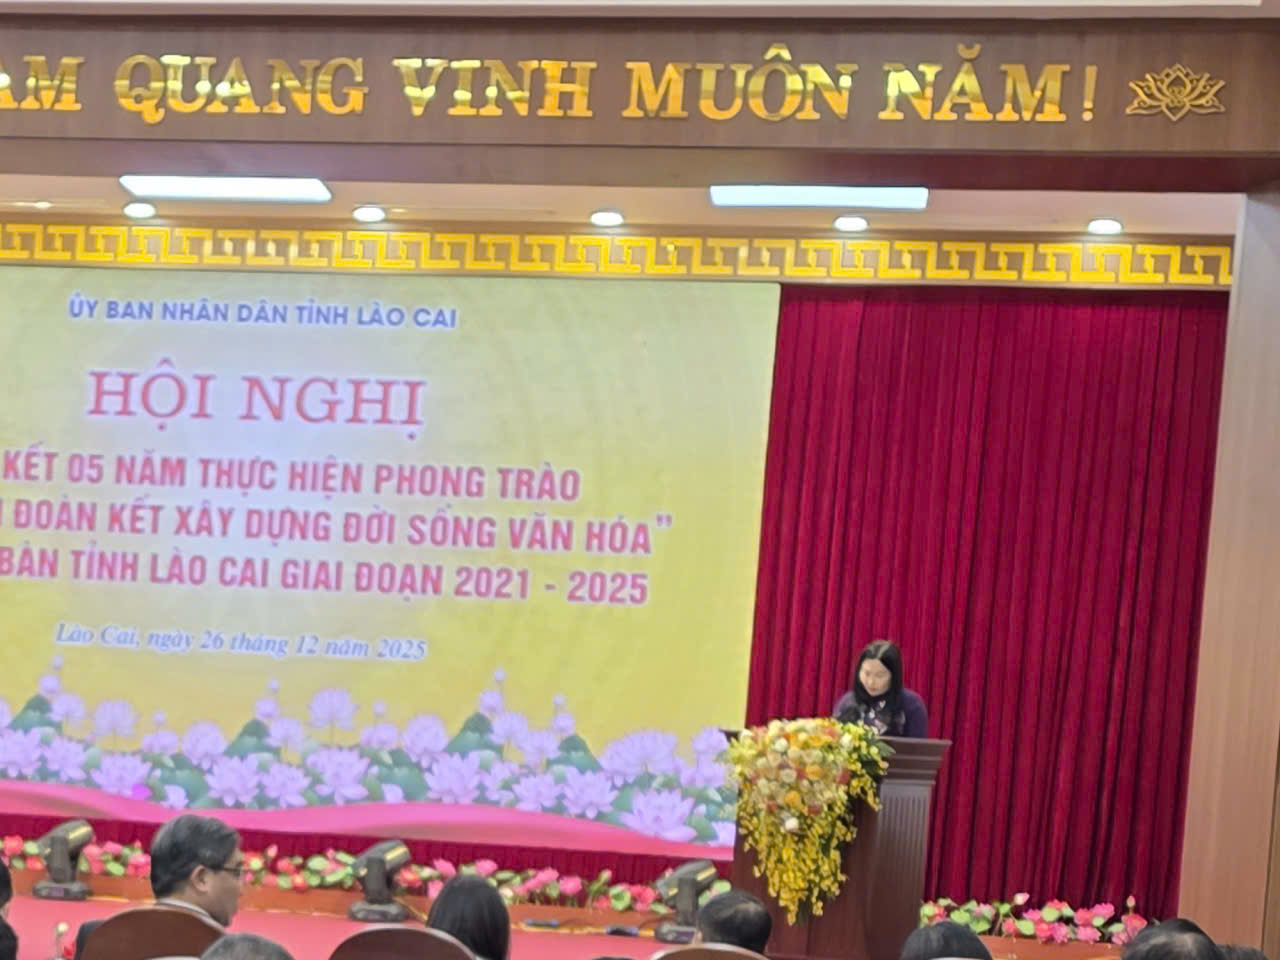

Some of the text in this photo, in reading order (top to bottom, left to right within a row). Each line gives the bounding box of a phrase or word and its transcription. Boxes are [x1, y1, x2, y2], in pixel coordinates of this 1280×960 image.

[114, 54, 369, 124] QUANG
[392, 57, 598, 118] VINH
[622, 43, 859, 122] MUÔN
[879, 43, 1096, 123] NĂM!
[69, 292, 457, 329] ỦY BAN NHÂN DÂN TỈNH LÀO CAI
[88, 358, 426, 440] HỘI NGHỊ
[3, 441, 58, 482] KẾT
[68, 454, 104, 484] 05
[115, 450, 185, 487] NĂM
[200, 458, 277, 497] THỰC
[288, 456, 361, 500] HIỆN
[374, 464, 485, 497] PHONG
[497, 463, 579, 500] TRÀO
[14, 494, 97, 532] ĐOÀN
[108, 493, 162, 535] KẾT
[175, 503, 234, 539] XÂY
[245, 507, 331, 547] DỰNG
[343, 504, 394, 544] ĐỜI
[407, 504, 496, 548] SỐNG
[508, 513, 574, 551] VĂN
[70, 540, 138, 582] TỈNH
[150, 549, 206, 586] LÀO
[219, 557, 268, 587] CAI
[281, 558, 342, 591] GIAI
[355, 561, 443, 601] ĐOẠN
[454, 567, 529, 599] 2021
[567, 571, 648, 604] 2025
[56, 623, 426, 659] Lào Cai, ngày 26 tháng 12 năm 2025
